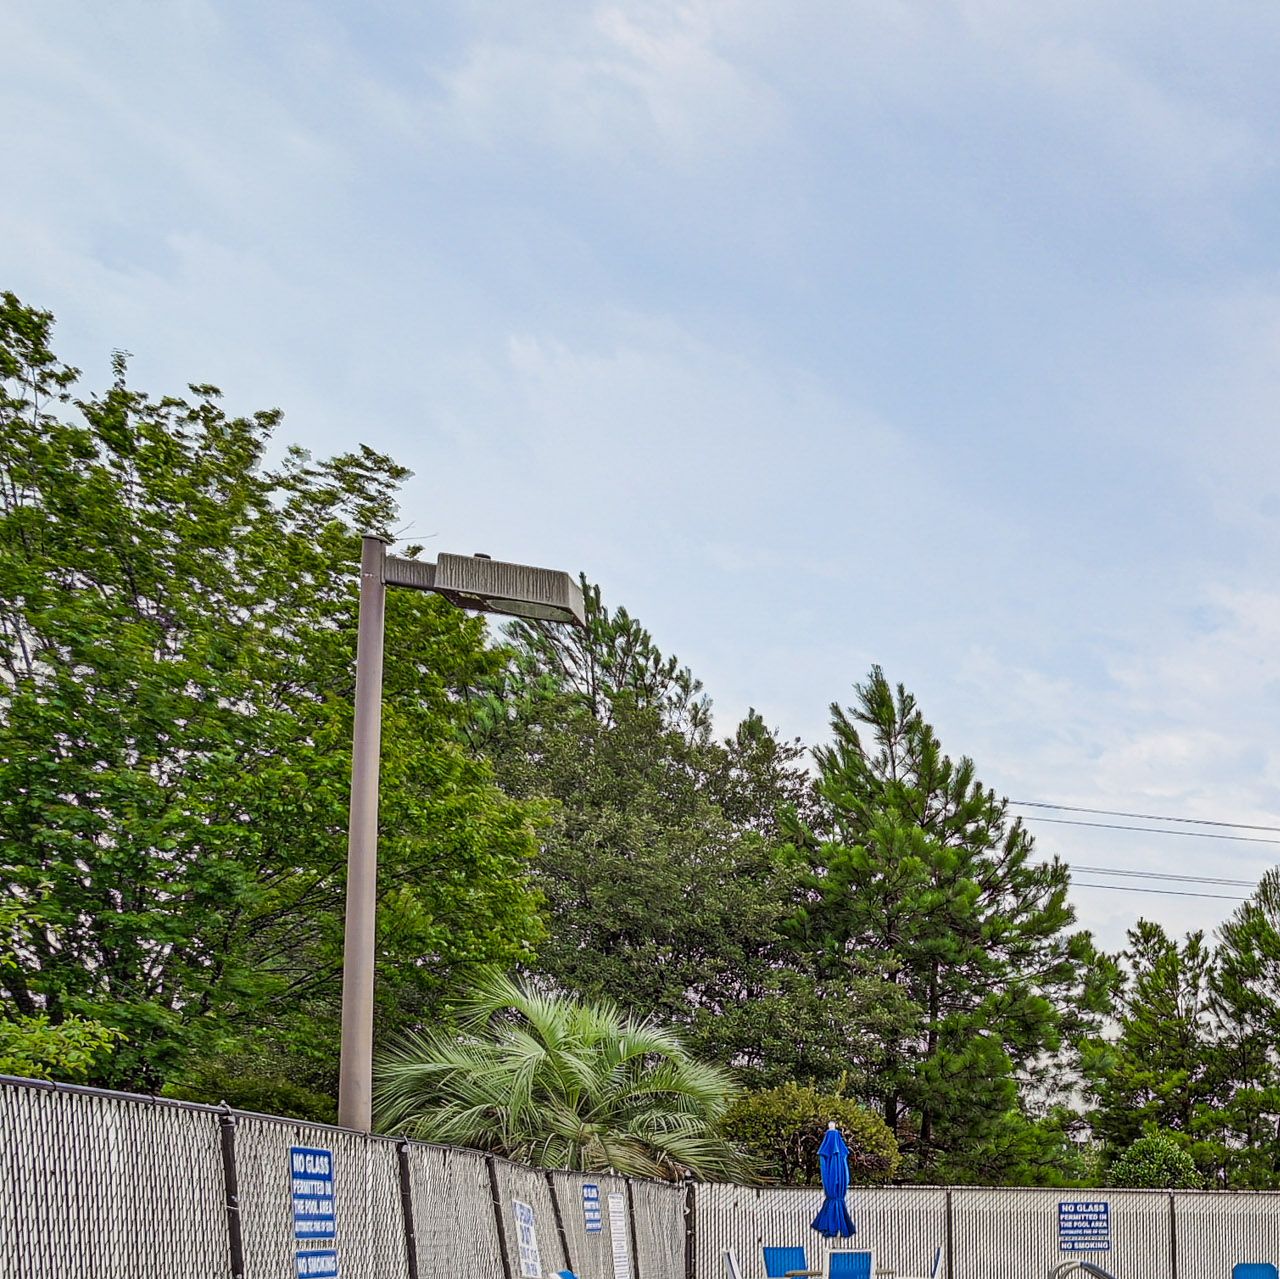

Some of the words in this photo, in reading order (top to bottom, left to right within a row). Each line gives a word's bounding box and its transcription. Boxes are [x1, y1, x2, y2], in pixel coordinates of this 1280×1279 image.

[292, 1152, 305, 1173] NO
[305, 1153, 330, 1175] GLASS
[294, 1200, 305, 1214] THE
[304, 1200, 319, 1215] POOL
[1061, 1204, 1075, 1213] NO
[1076, 1204, 1105, 1213] GLASS
[1060, 1213, 1098, 1221] PERMITTED
[1099, 1213, 1107, 1221] IN
[1061, 1242, 1073, 1250] NO
[1073, 1242, 1108, 1250] SMOKING
[297, 1257, 307, 1273] NO
[307, 1255, 336, 1273] SMOKING
